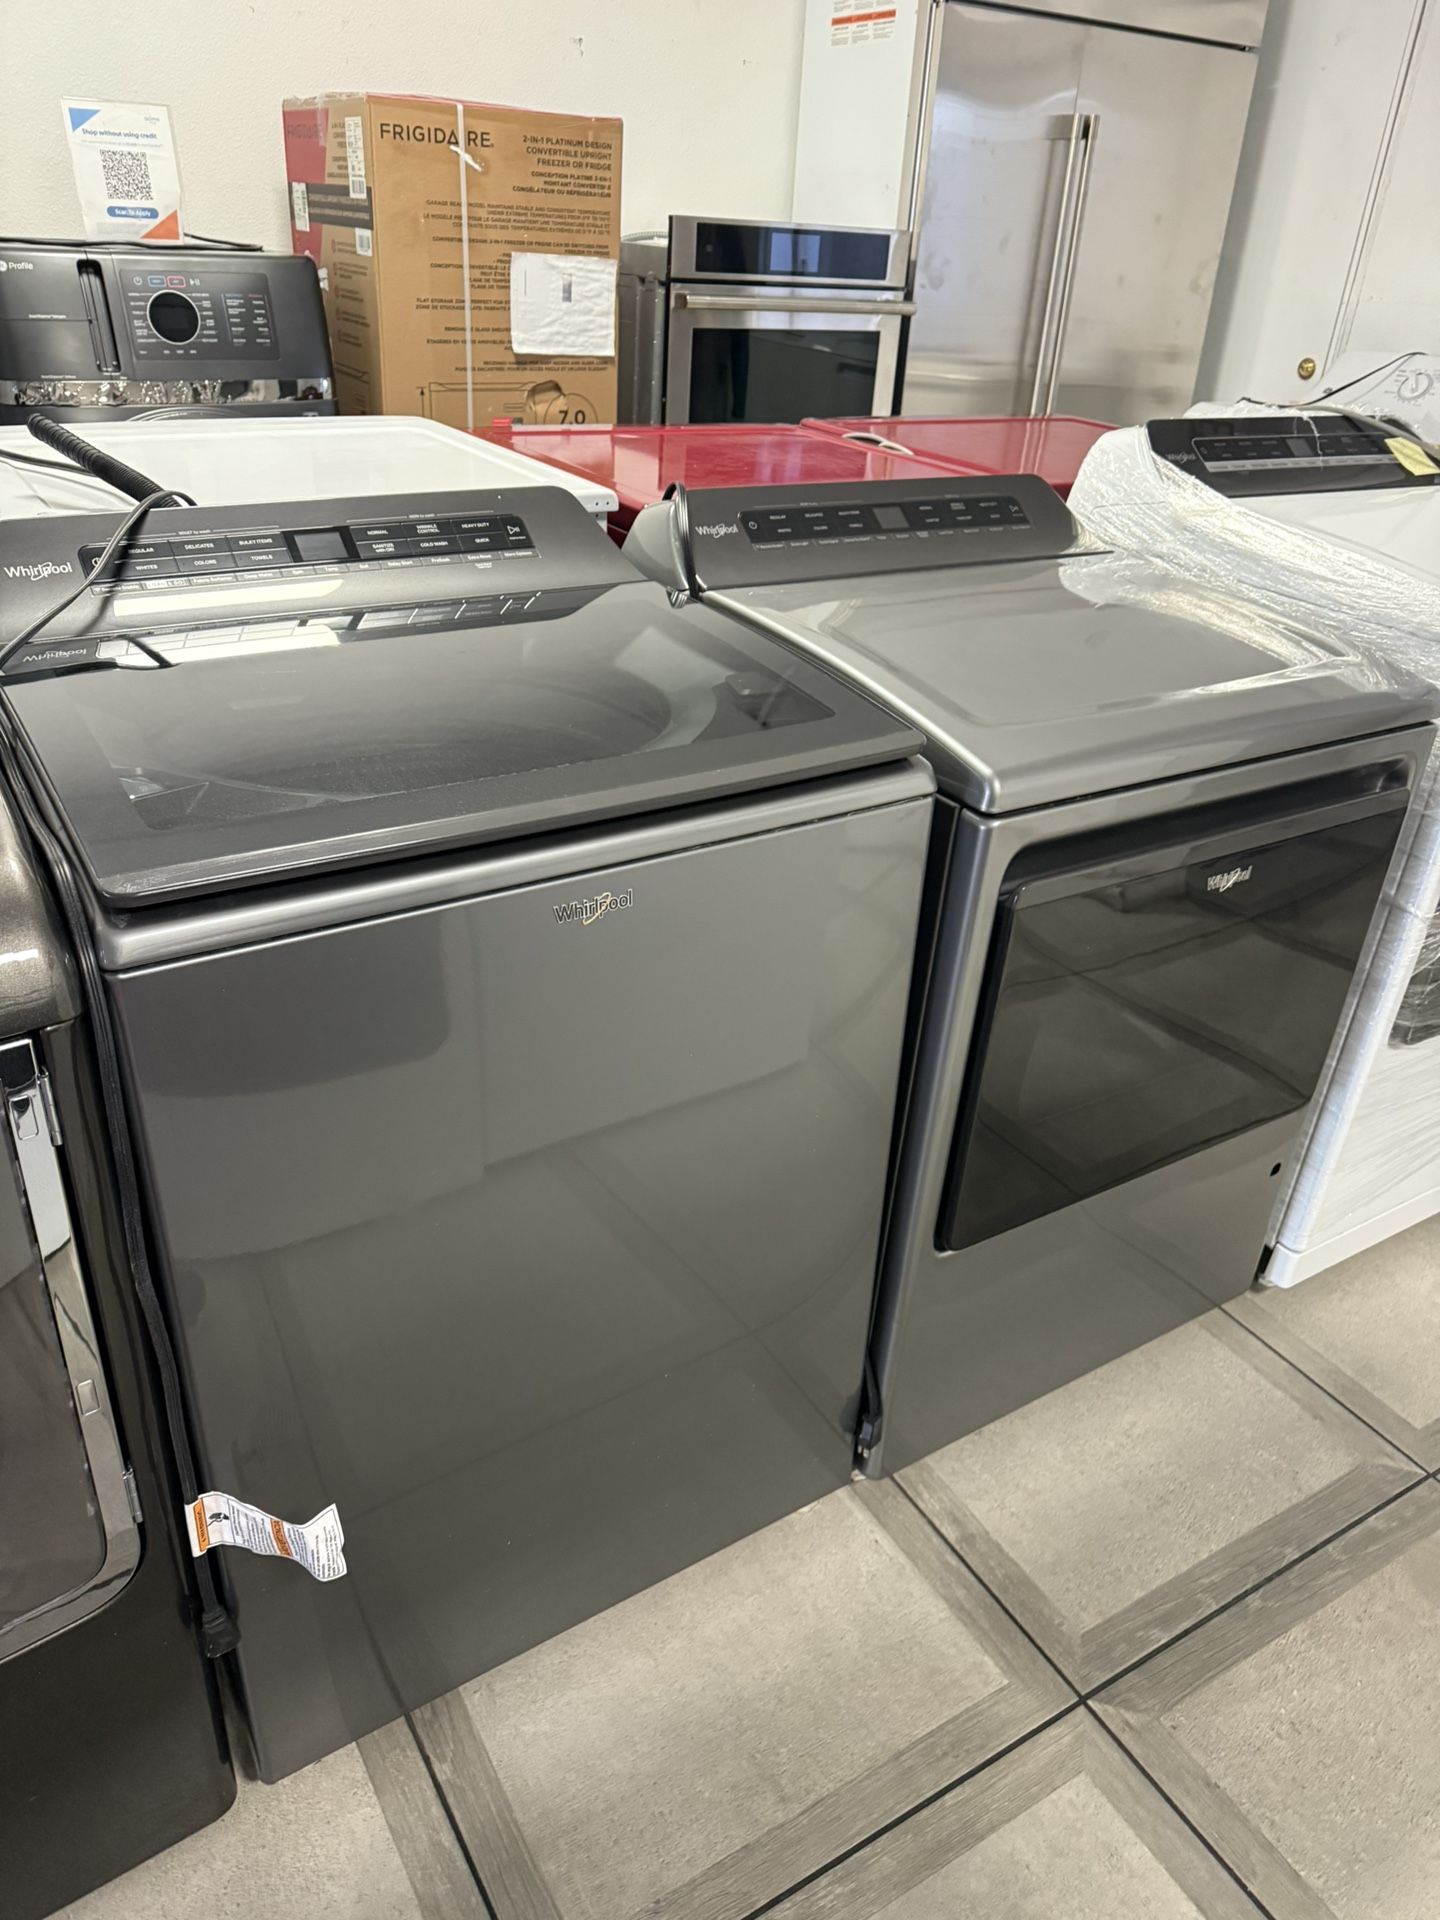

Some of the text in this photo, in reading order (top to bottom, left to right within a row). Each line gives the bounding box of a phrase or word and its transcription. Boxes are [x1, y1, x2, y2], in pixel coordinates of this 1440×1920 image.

[82, 128, 97, 136] Shop
[99, 129, 122, 137] without
[380, 123, 491, 148] FRIGIDARE
[522, 134, 612, 150] 2-IN-1 PLATINUM DESIGN
[526, 146, 612, 161] CONVERTIBLE UPRIGHT
[537, 158, 612, 171] FREEZER OR FRIDGE
[531, 171, 568, 179] CONCEPTION
[9, 262, 33, 270] Profile
[559, 410, 586, 425] 7.0
[695, 524, 739, 538] Whirlpool
[4, 562, 72, 581] Whirlpool
[1207, 865, 1253, 892] Whirlpool
[553, 888, 633, 925] Whirlpool
